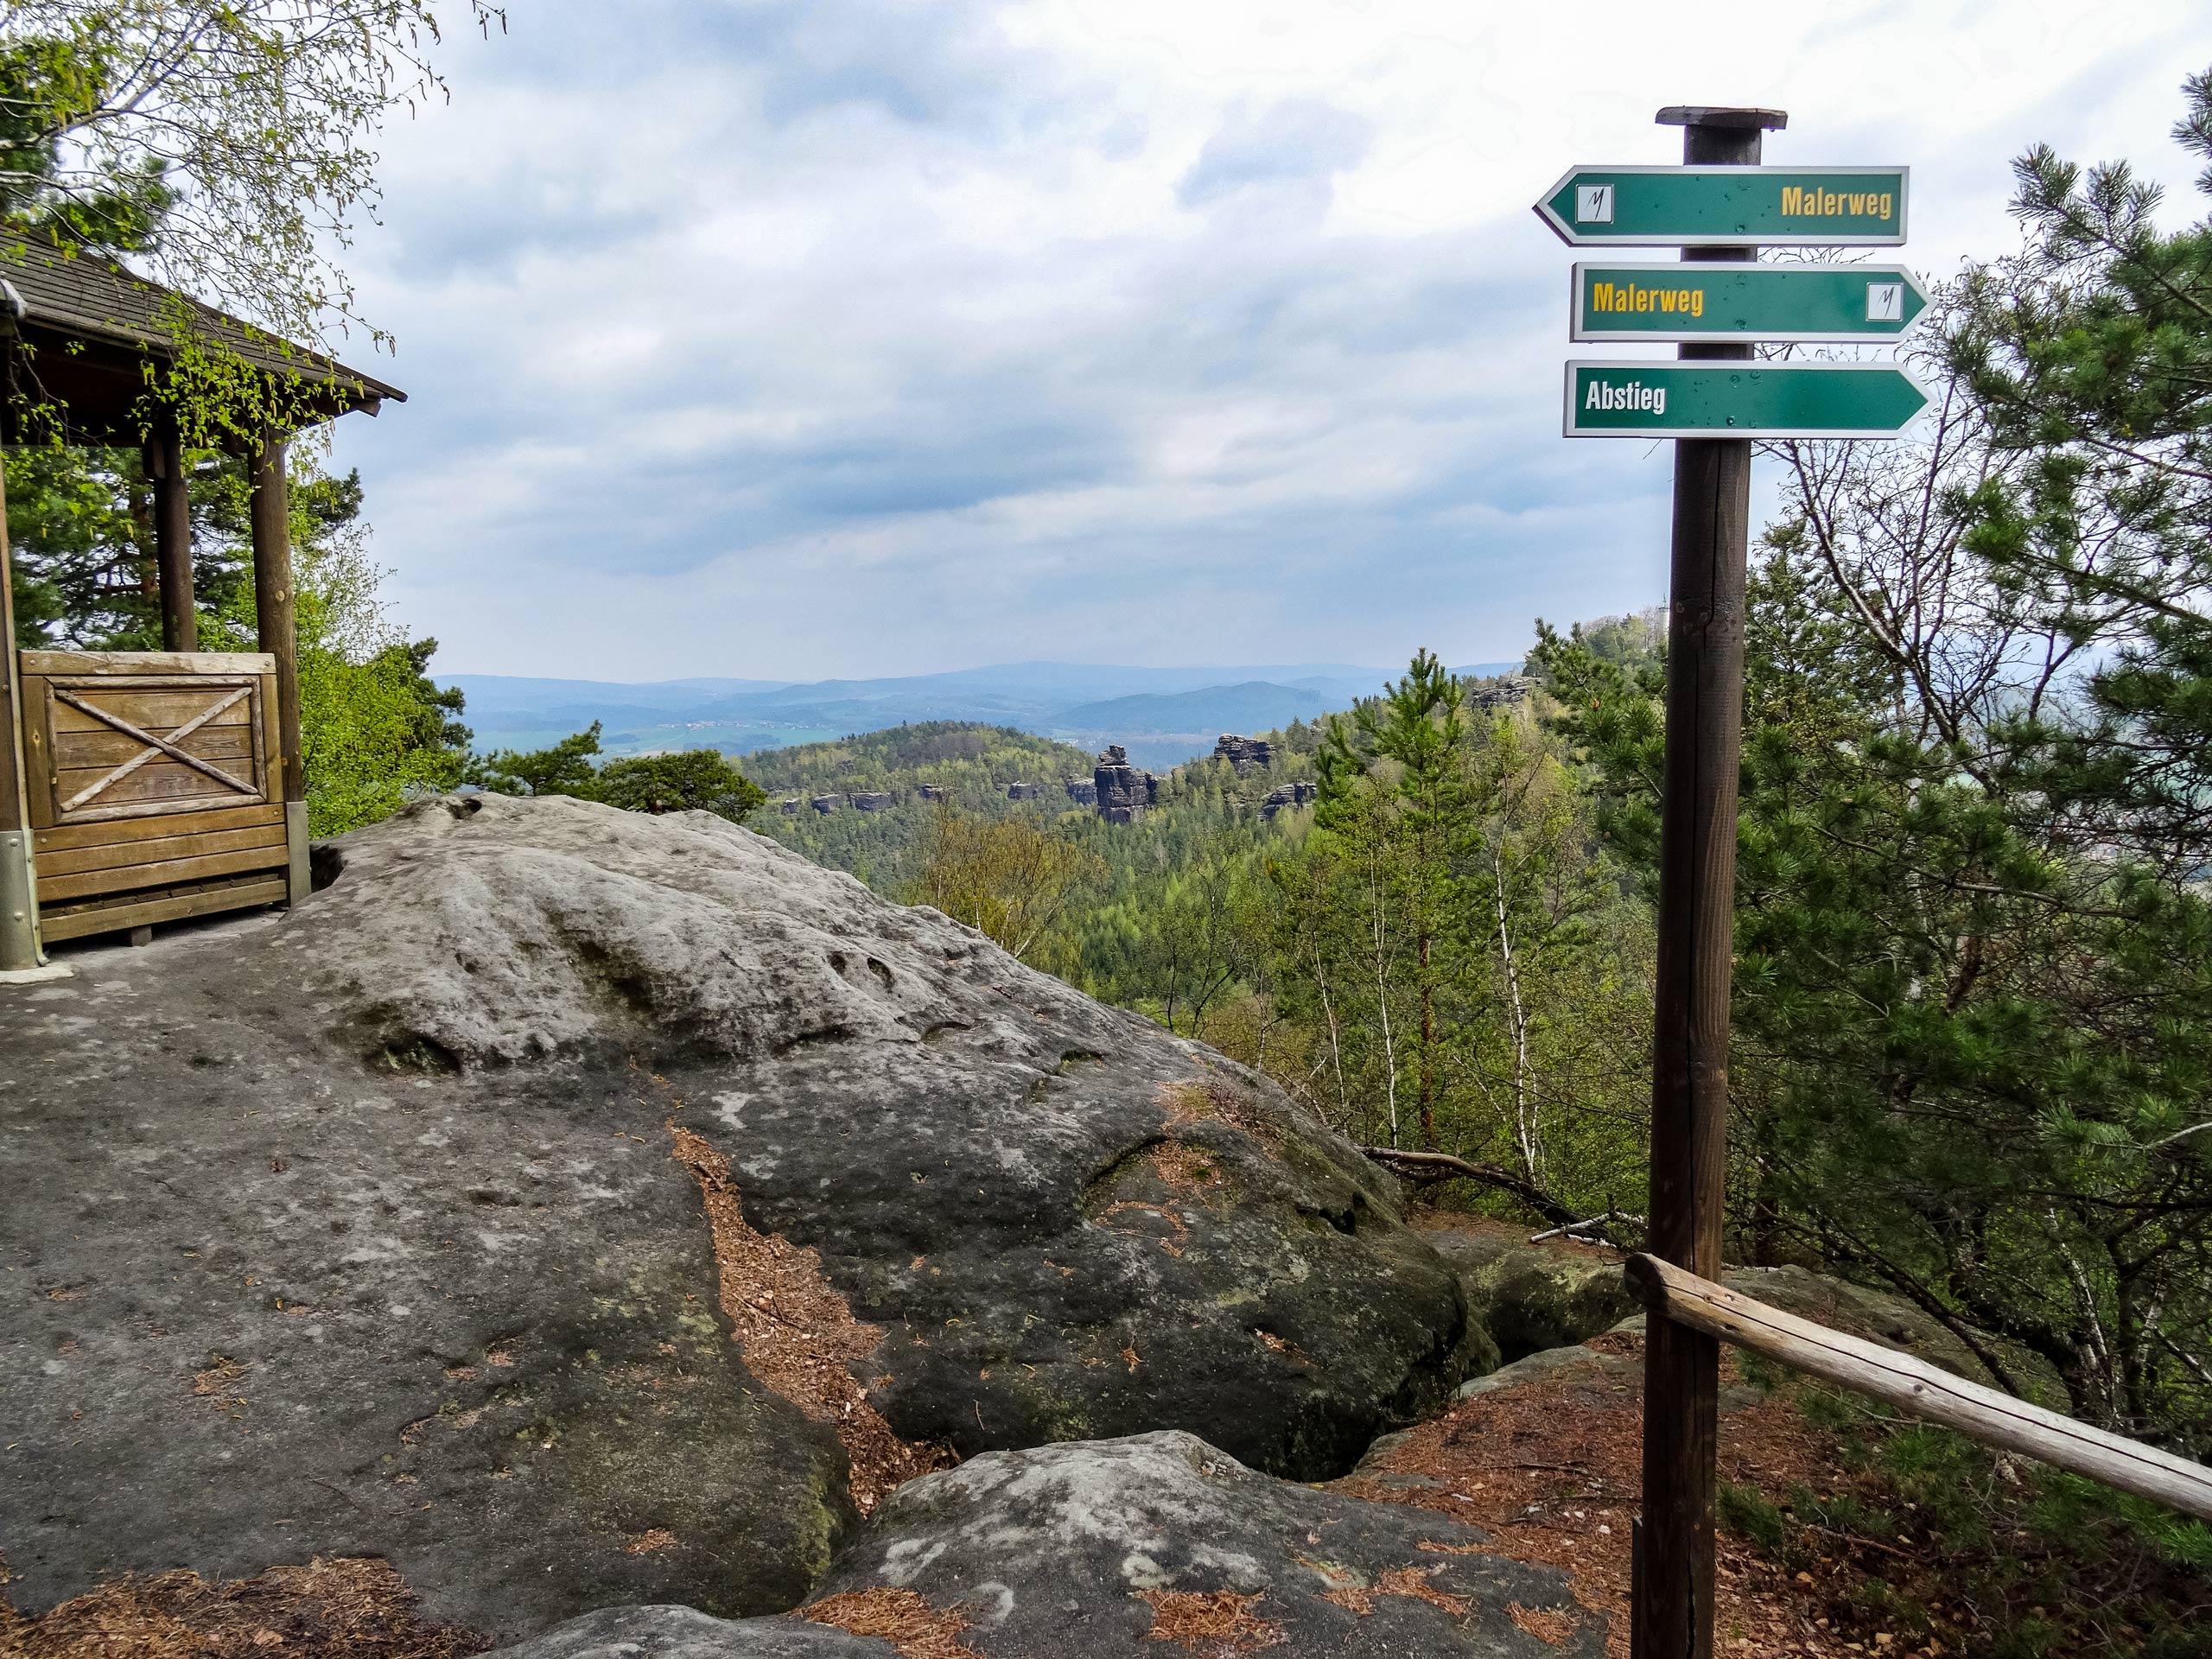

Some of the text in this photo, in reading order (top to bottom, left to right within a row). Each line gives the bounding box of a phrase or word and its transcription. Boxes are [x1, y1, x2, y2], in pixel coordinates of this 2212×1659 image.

[1782, 187, 1892, 219] Malerweg
[1592, 283, 1704, 317] Malerweg
[1585, 381, 1666, 415] Abstieg
